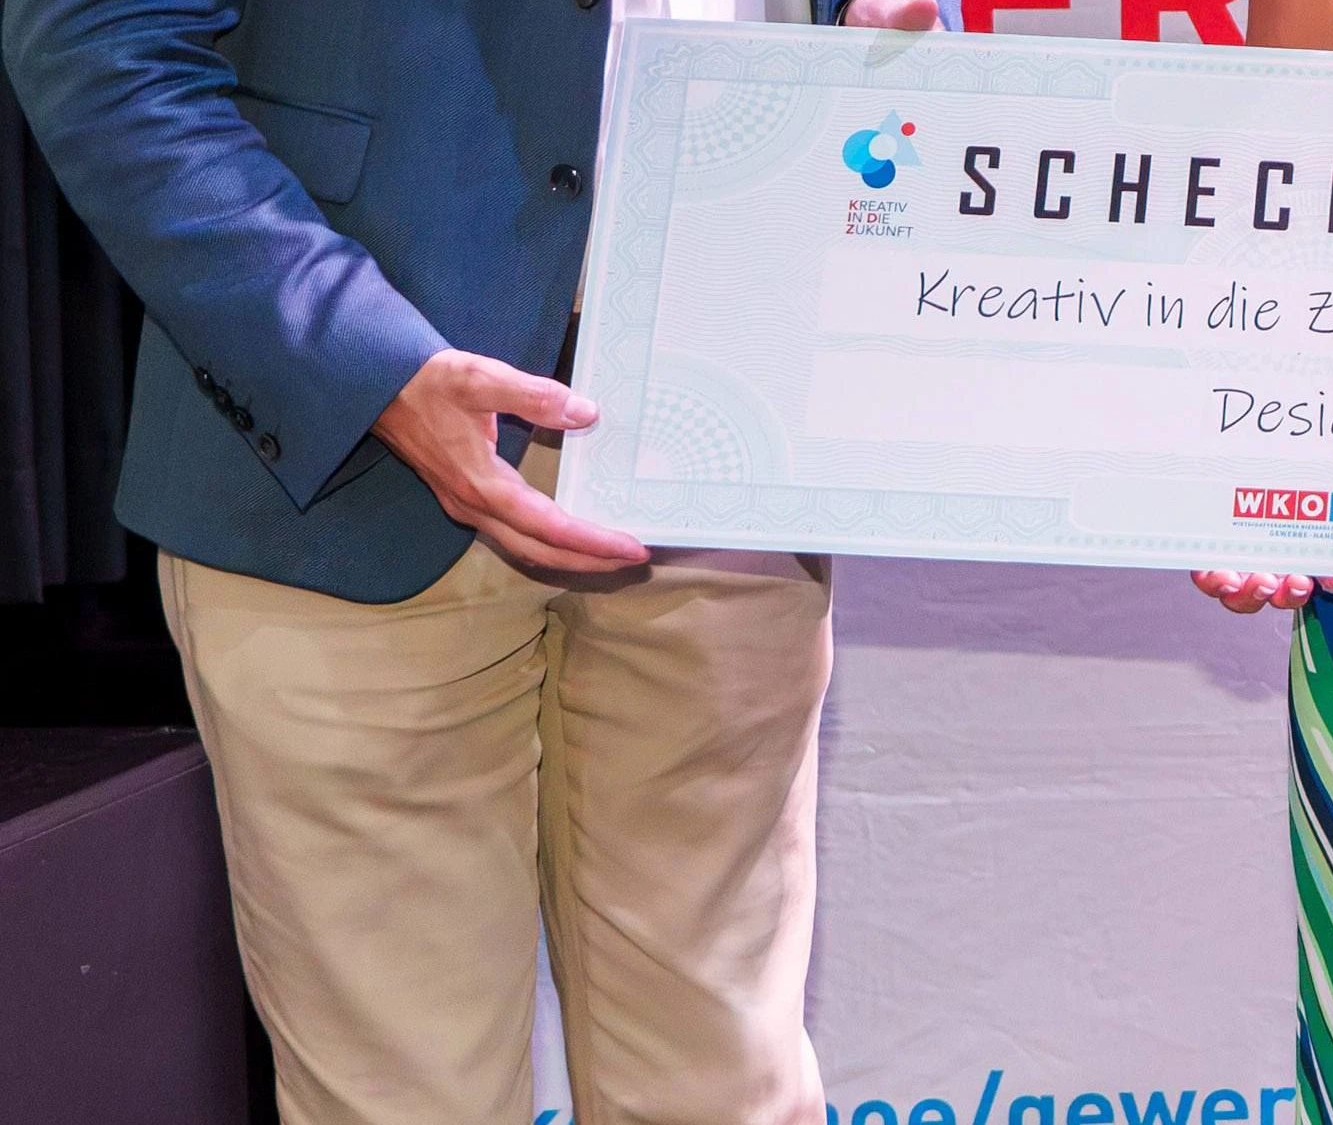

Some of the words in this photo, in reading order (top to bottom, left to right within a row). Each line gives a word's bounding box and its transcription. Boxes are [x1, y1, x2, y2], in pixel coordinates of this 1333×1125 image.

[849, 200, 908, 213] KREATIV
[847, 212, 863, 223] IN
[867, 212, 891, 225] DIE
[846, 224, 914, 239] ZUKUNFT
[917, 268, 1126, 326] Kreativ
[1146, 282, 1184, 329] in
[1207, 281, 1281, 331] die
[1236, 491, 1325, 517] WKO
